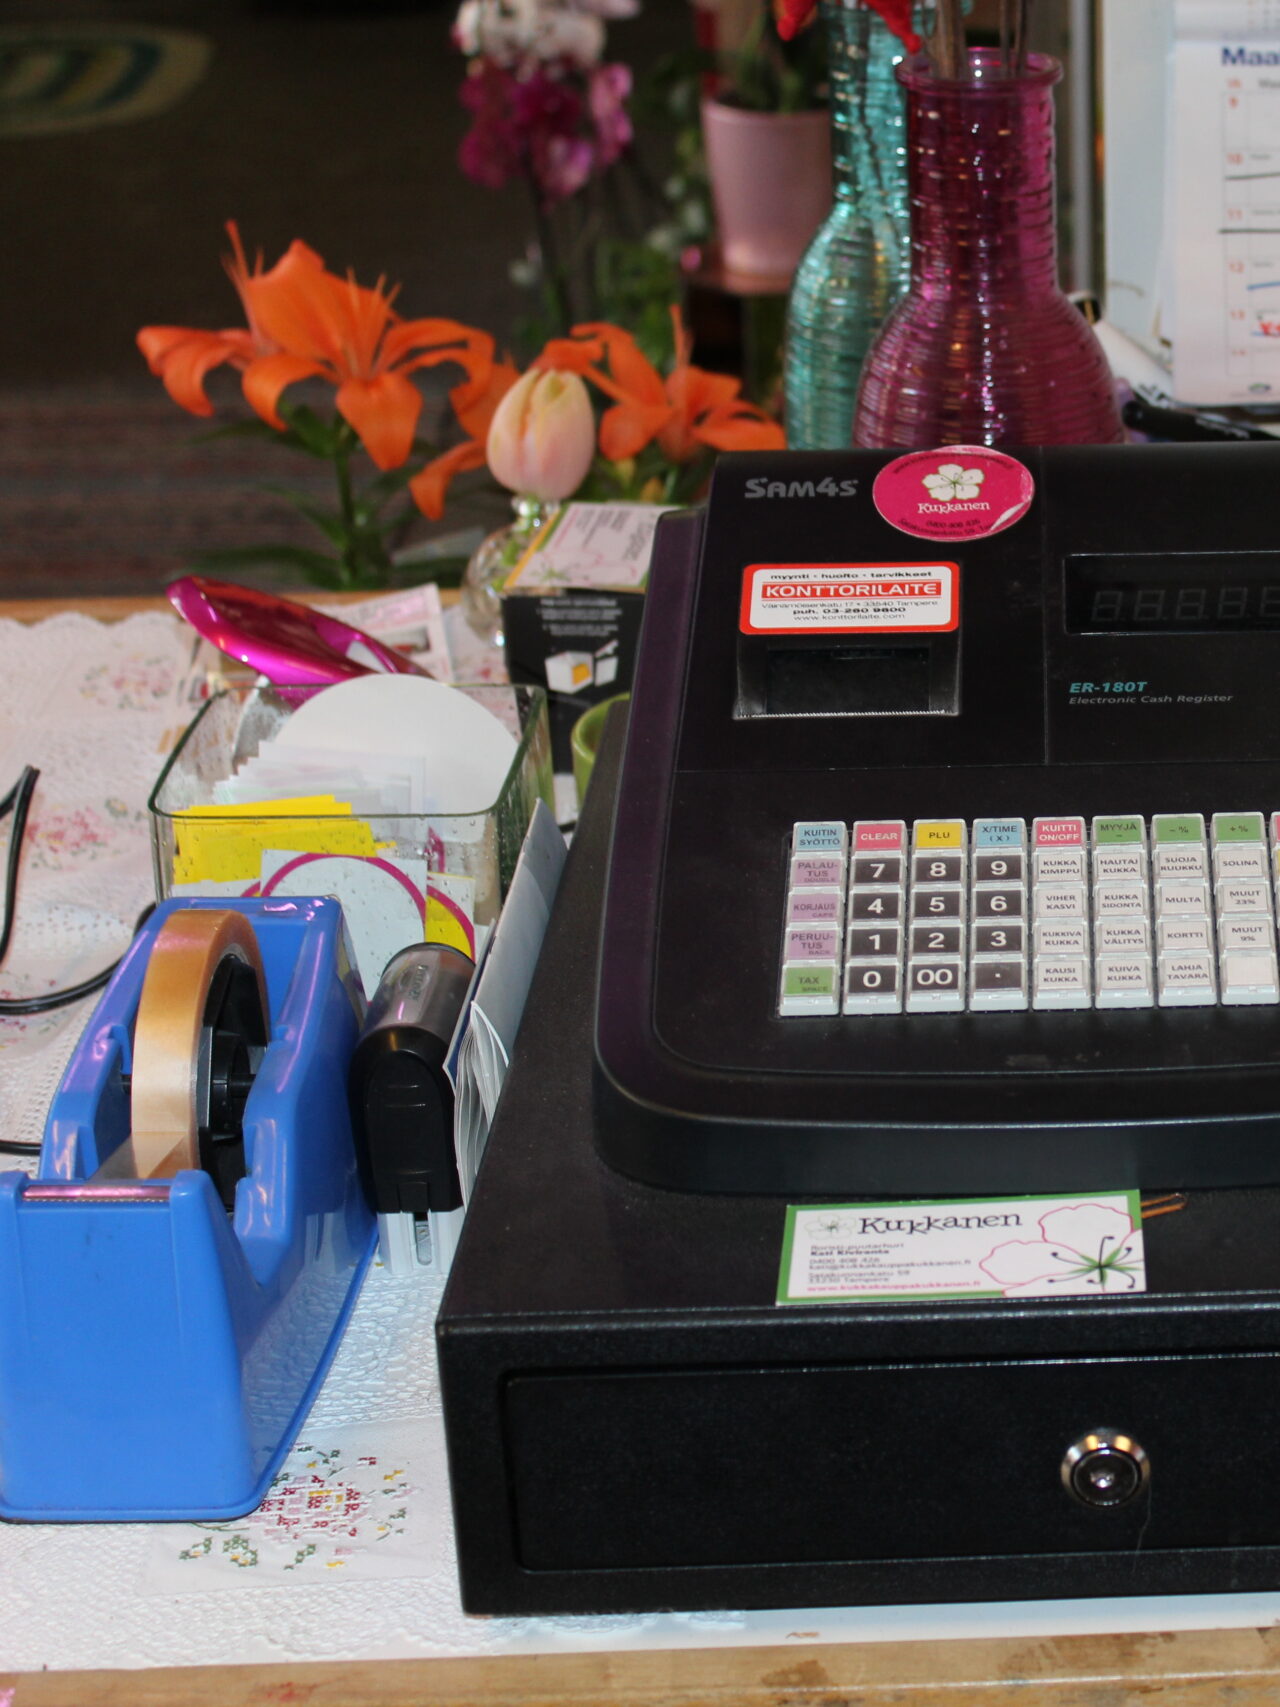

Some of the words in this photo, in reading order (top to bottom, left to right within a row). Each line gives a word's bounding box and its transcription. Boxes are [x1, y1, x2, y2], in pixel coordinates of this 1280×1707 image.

[917, 502, 991, 514] Kukkanen
[766, 583, 937, 597] KONTTORILAITE
[1068, 681, 1148, 694] ER-180T
[1069, 695, 1136, 706] Electronic
[1141, 695, 1172, 703] Cash
[1176, 694, 1234, 704] Register
[1101, 822, 1137, 831] MYYJÄ
[860, 833, 898, 841] CLEAR
[928, 831, 950, 839] PLU
[1039, 834, 1079, 842] ON/OFF
[800, 837, 840, 845] SYÖTTÖ
[798, 862, 838, 870] PALAU-
[930, 862, 946, 877] 8
[991, 861, 1008, 875] 9
[1103, 866, 1137, 874] KUKKA
[870, 863, 886, 878] 7
[1040, 867, 1080, 875] KIMPPU
[1230, 889, 1261, 897] MUUT
[1046, 894, 1076, 902] VIHER
[1166, 896, 1201, 904] MULTA
[793, 903, 836, 911] KORJAUS
[868, 898, 884, 914] 4
[929, 897, 945, 912] 5
[990, 896, 1007, 911] 6
[1106, 929, 1141, 937] KUKKA
[1231, 926, 1263, 934] MUUT
[791, 933, 834, 941] PERUU-
[991, 931, 1006, 946] 3
[1167, 931, 1203, 939] KORTTI
[869, 934, 881, 950] 1
[928, 932, 944, 948] 2
[1045, 938, 1079, 946] KUKKA
[1104, 936, 1144, 945] VÄLITYS
[802, 941, 823, 949] TUS
[1108, 965, 1140, 973] KUIVA
[1171, 963, 1202, 972] LAHJA
[863, 972, 881, 987] 0
[917, 969, 952, 985] 00
[1044, 975, 1078, 983] KUKKA
[1107, 973, 1142, 981] KUKKA
[1168, 971, 1208, 980] TAVARA
[858, 1213, 1022, 1236] Kukkanen
